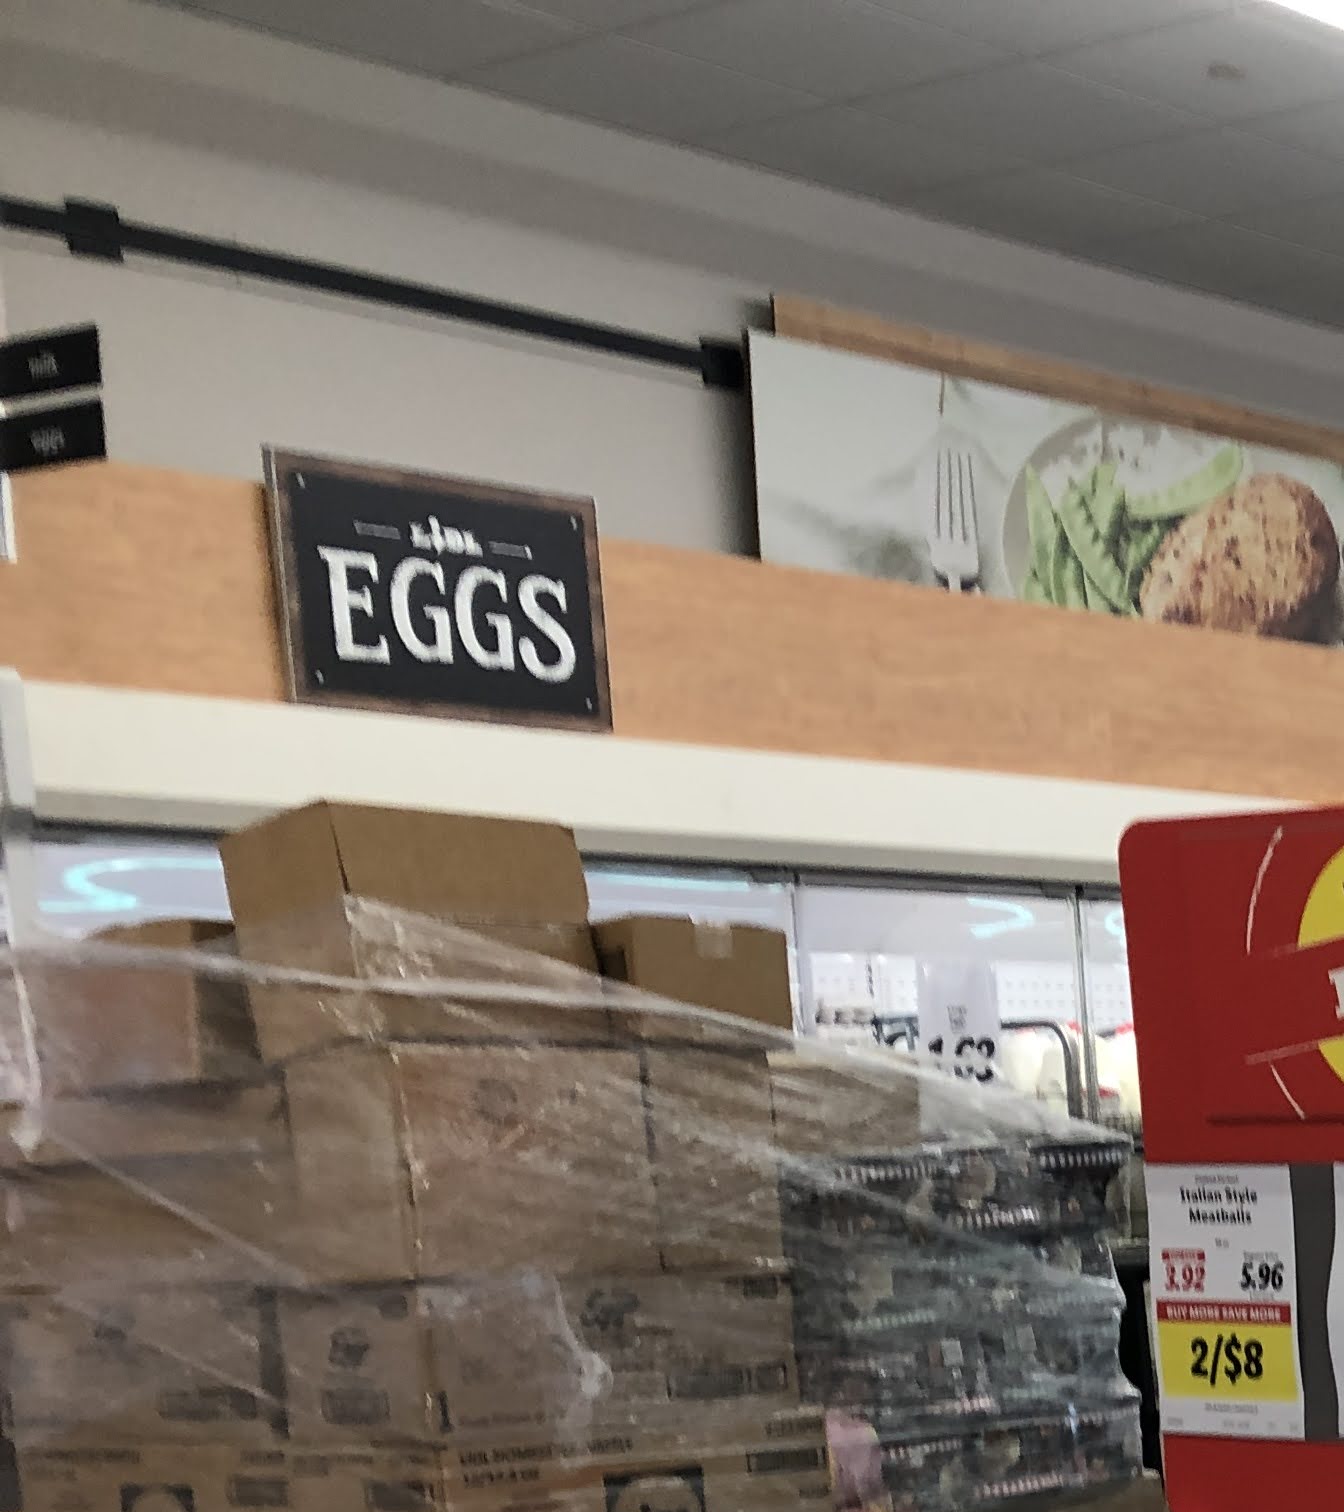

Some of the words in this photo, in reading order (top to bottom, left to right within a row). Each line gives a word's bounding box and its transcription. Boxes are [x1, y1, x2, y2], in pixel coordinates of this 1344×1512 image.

[317, 545, 576, 683] EGGS
[1180, 1185, 1223, 1203] Italian
[1225, 1185, 1258, 1207] Style
[1189, 1206, 1252, 1225] Meatballs
[1240, 1260, 1284, 1293] 5.96
[1166, 1304, 1188, 1320] BUY
[1190, 1332, 1264, 1388] 2/$8
